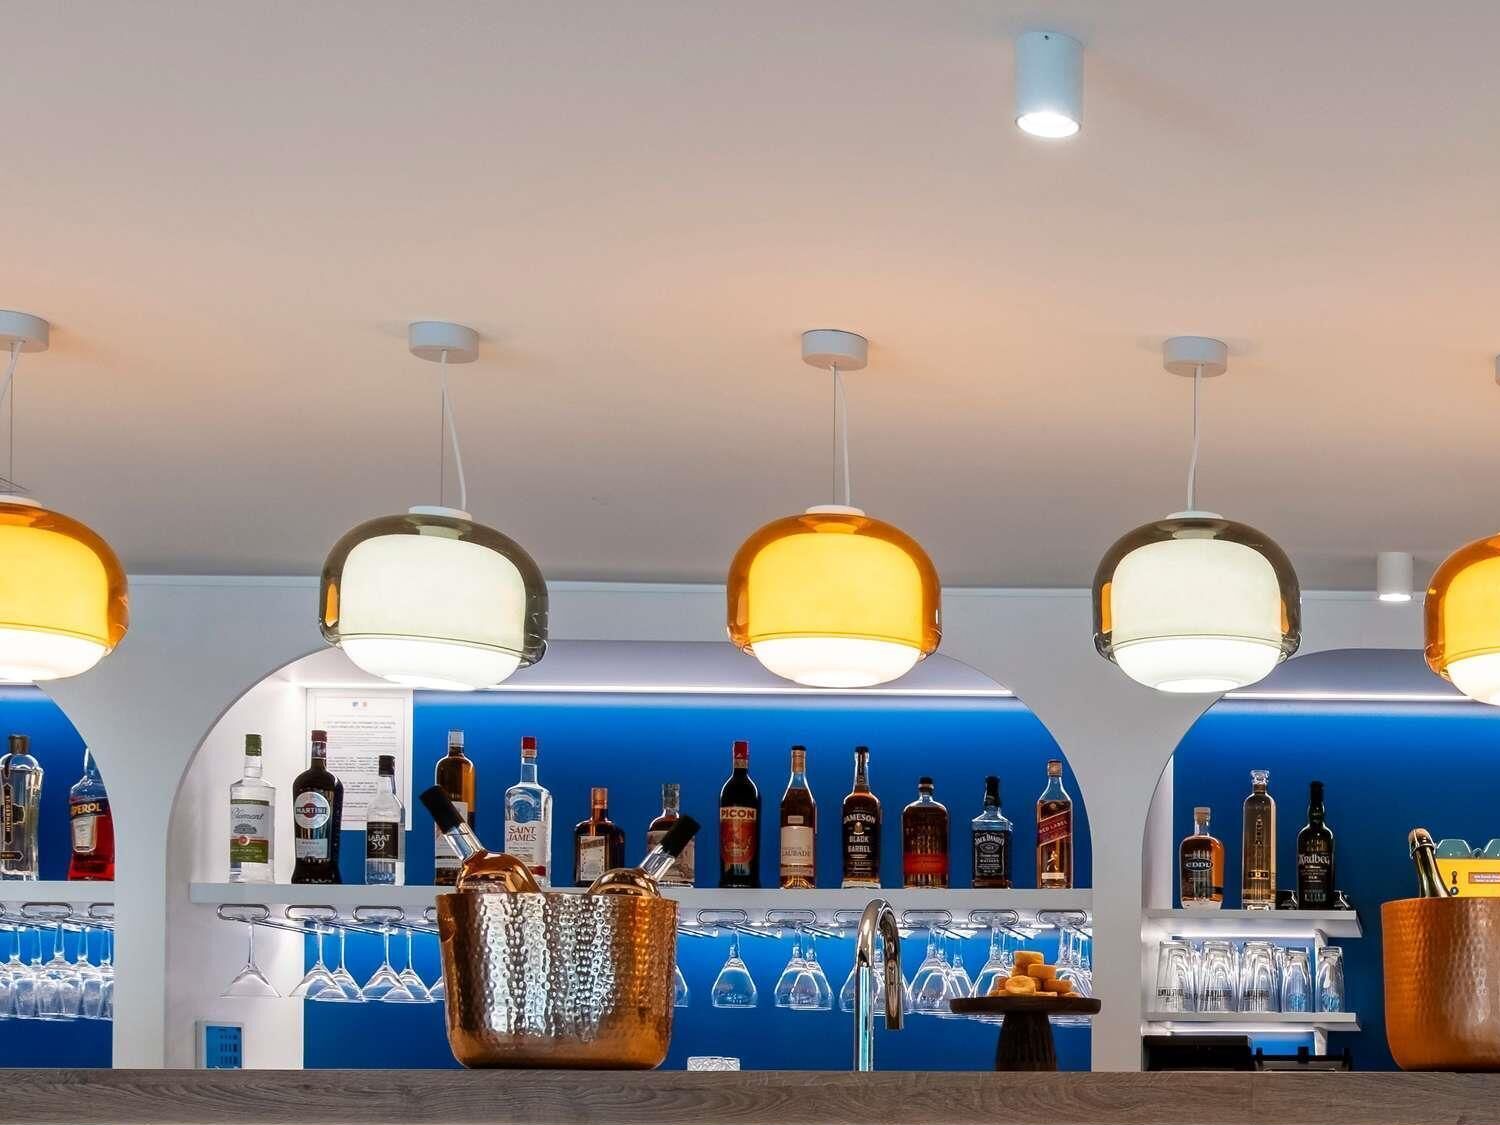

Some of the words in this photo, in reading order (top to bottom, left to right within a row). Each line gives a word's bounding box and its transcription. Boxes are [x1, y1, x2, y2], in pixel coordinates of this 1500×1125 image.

[721, 809, 754, 818] PICON
[843, 813, 876, 824] JAMESON
[507, 834, 537, 842] JAMES
[849, 835, 869, 843] BLACK
[847, 845, 871, 853] BARREL
